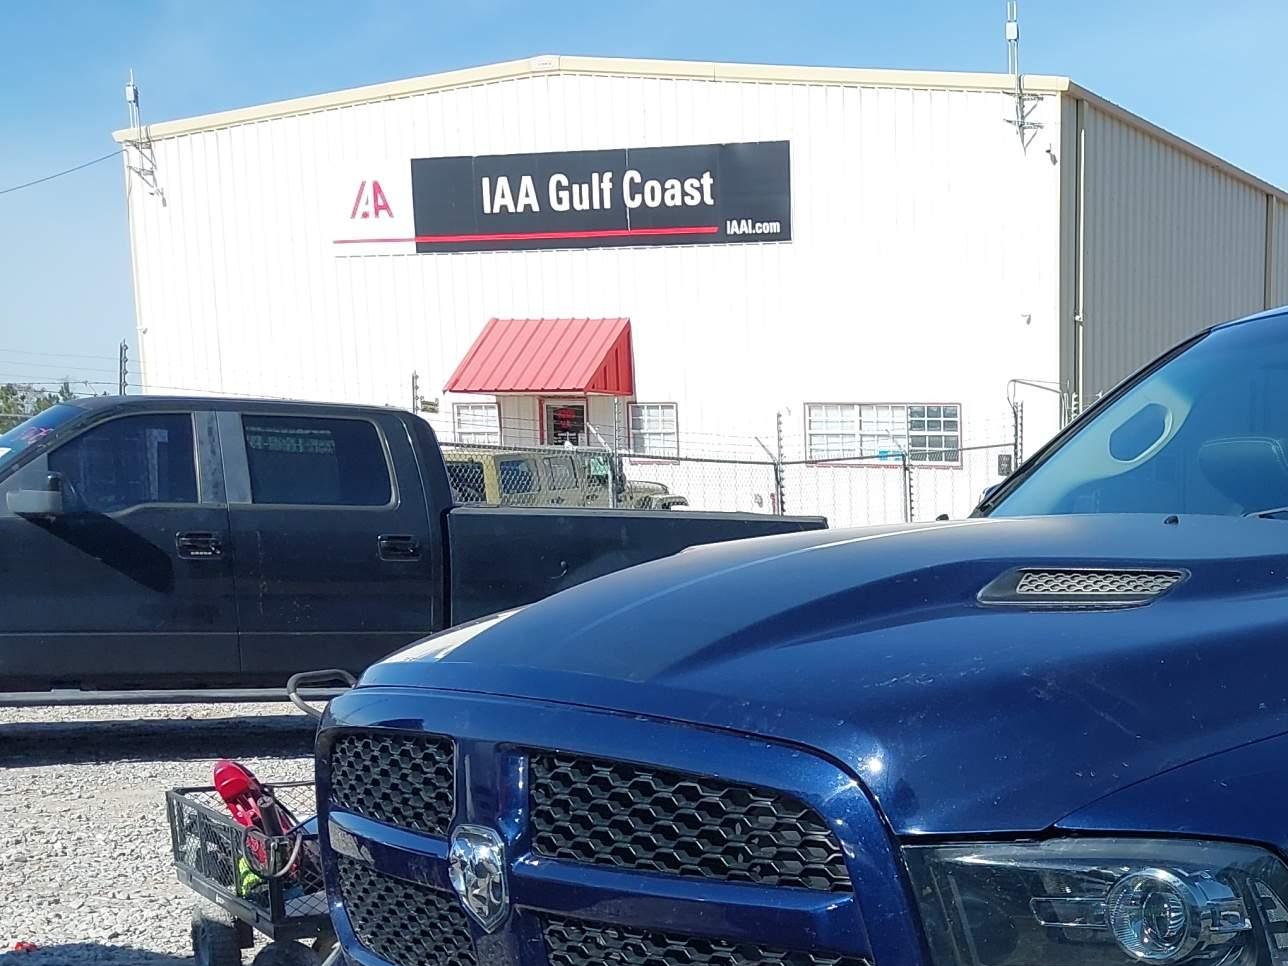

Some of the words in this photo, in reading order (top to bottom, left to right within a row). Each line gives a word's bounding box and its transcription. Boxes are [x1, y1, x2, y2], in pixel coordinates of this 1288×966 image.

[482, 175, 540, 214] IAA
[548, 171, 614, 212] Gulf
[622, 169, 715, 209] Coast
[726, 219, 781, 235] IAAI.com
